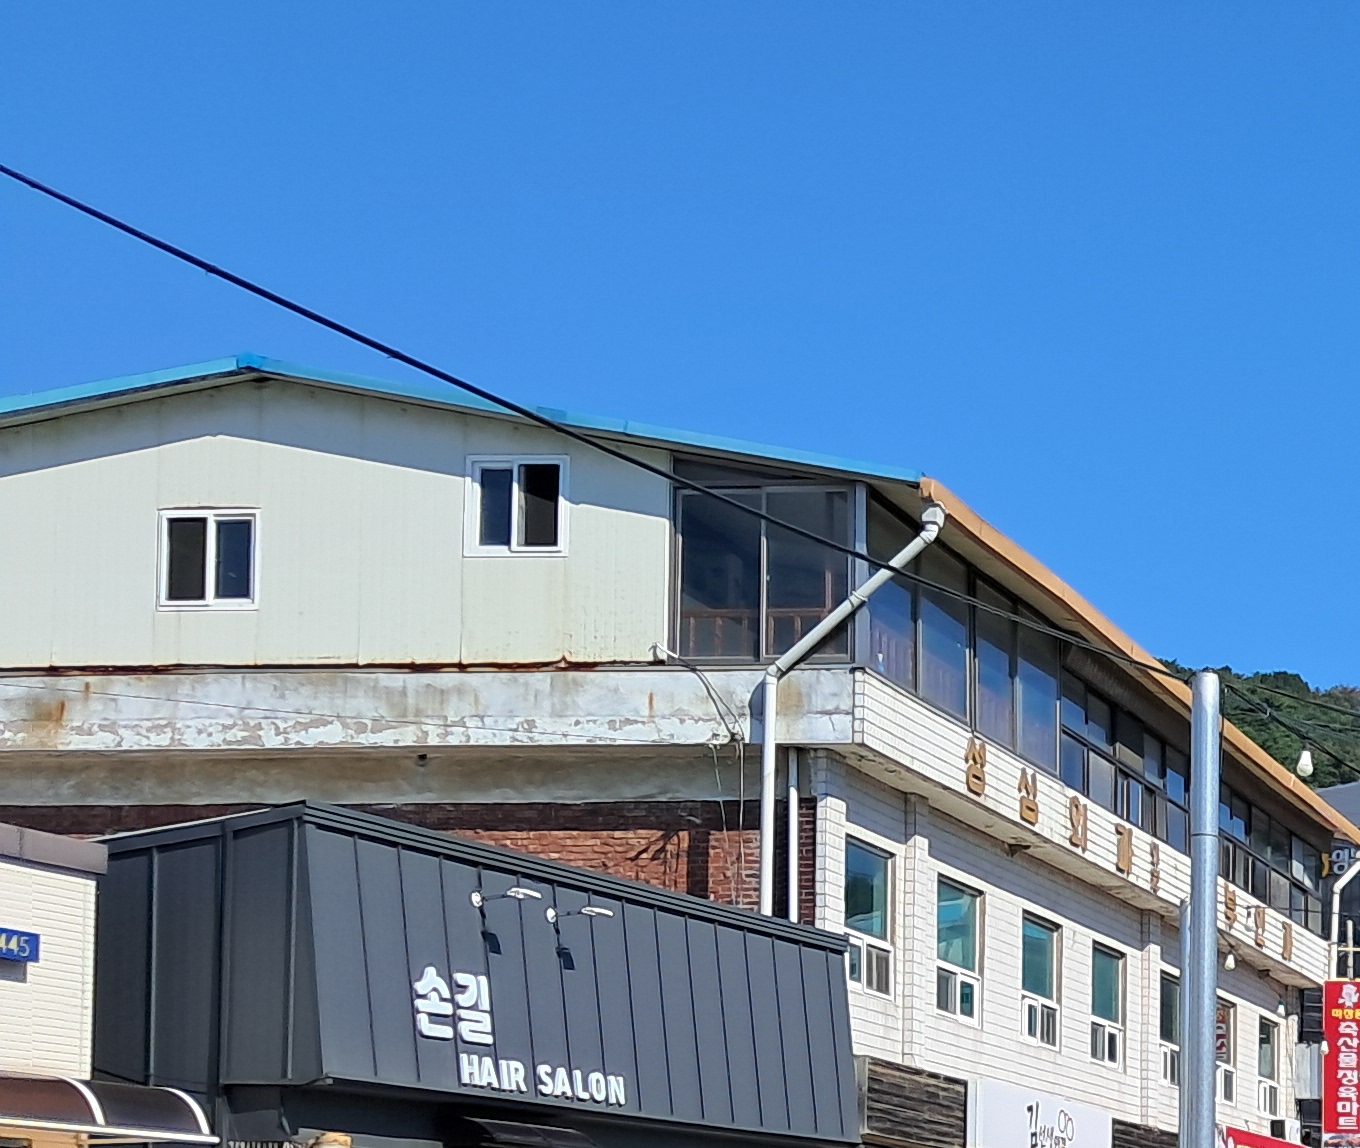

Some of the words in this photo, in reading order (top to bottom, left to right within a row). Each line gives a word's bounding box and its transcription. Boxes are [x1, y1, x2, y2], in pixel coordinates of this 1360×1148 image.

[413, 966, 494, 1045] 손길
[459, 1053, 527, 1092] HAIR
[536, 1064, 627, 1106] SALON
